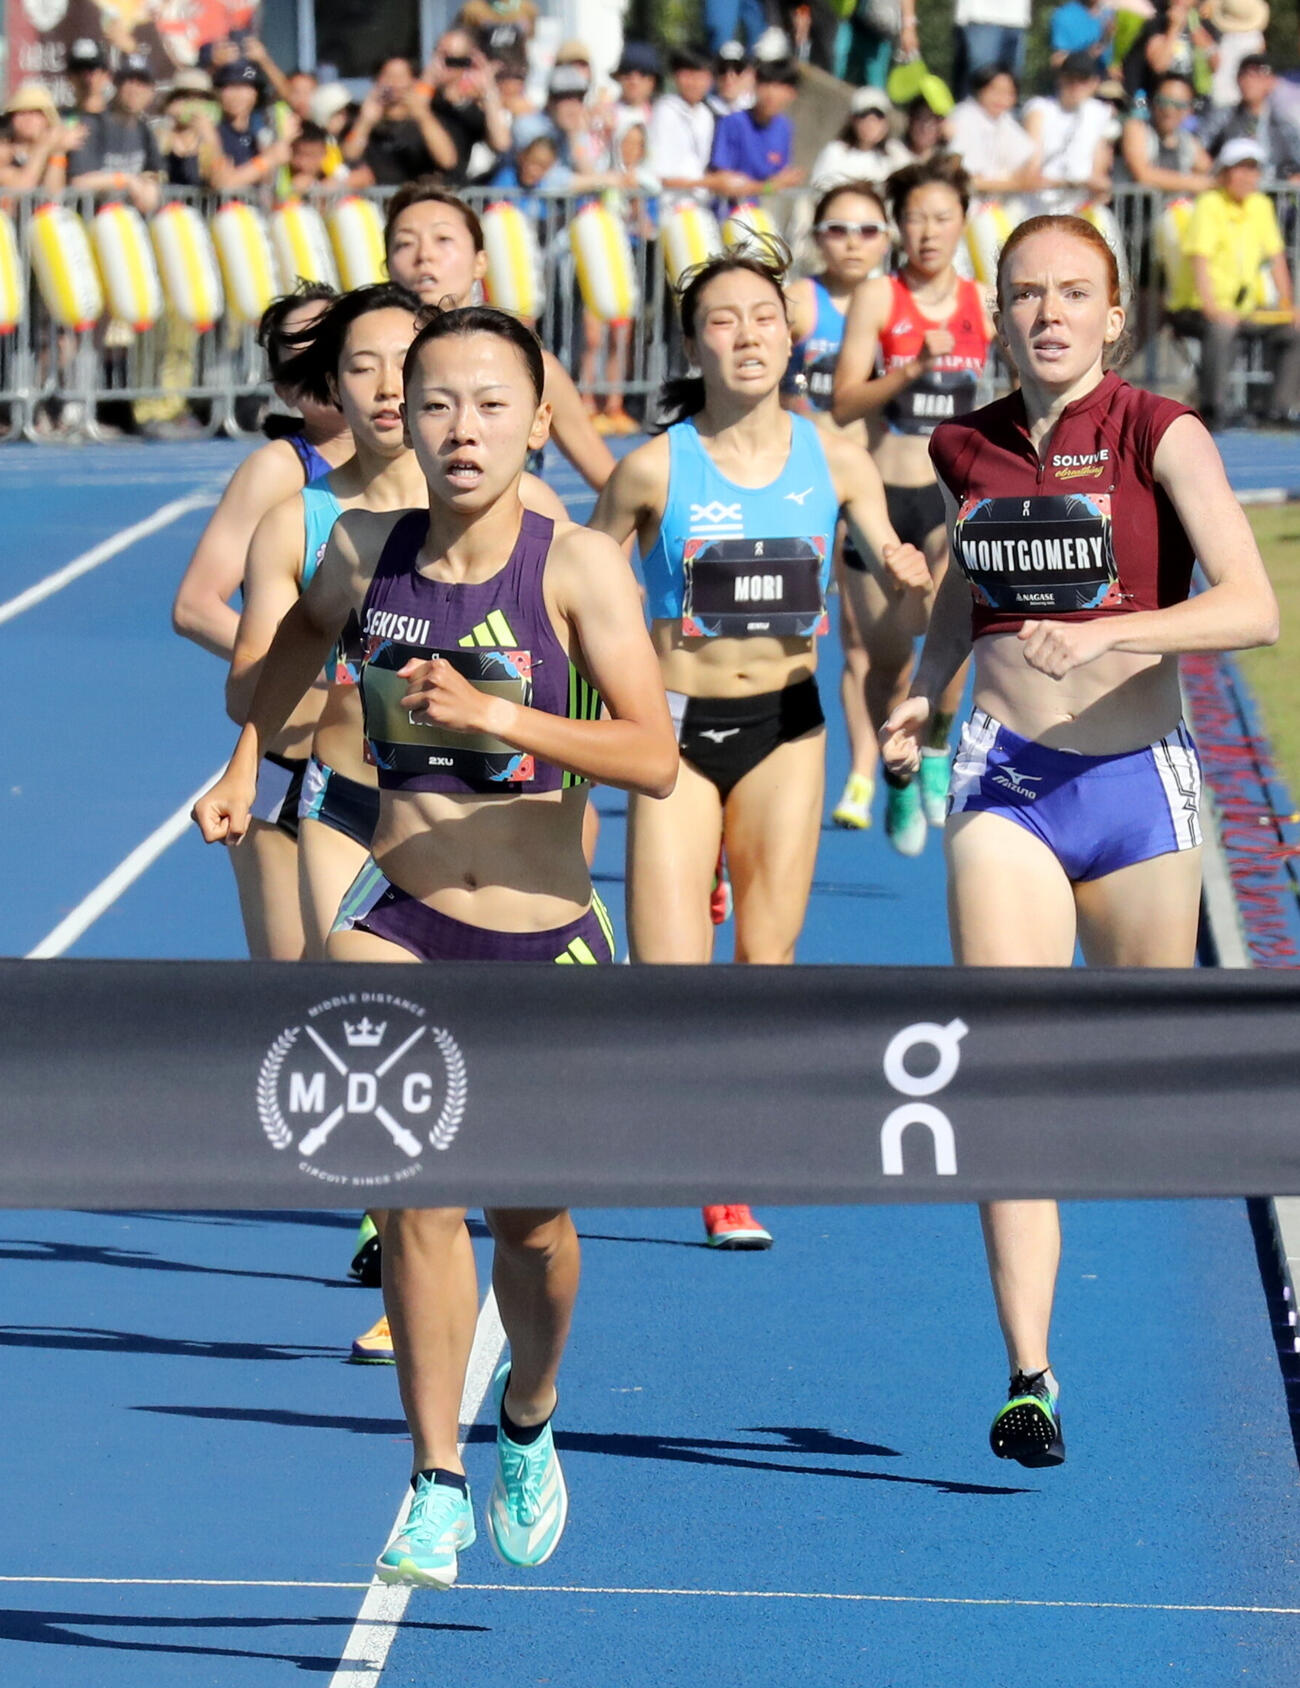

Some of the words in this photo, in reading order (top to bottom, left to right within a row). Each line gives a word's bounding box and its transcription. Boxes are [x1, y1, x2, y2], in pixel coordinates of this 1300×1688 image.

[961, 536, 1103, 572] MONTGOMERY
[734, 575, 783, 602] MORI
[1022, 593, 1055, 602] NAGASE
[363, 607, 430, 645] SEKISUI
[428, 756, 454, 766] 2XU
[991, 774, 1037, 800] MIZUNO
[361, 992, 426, 1018] DISTANCE
